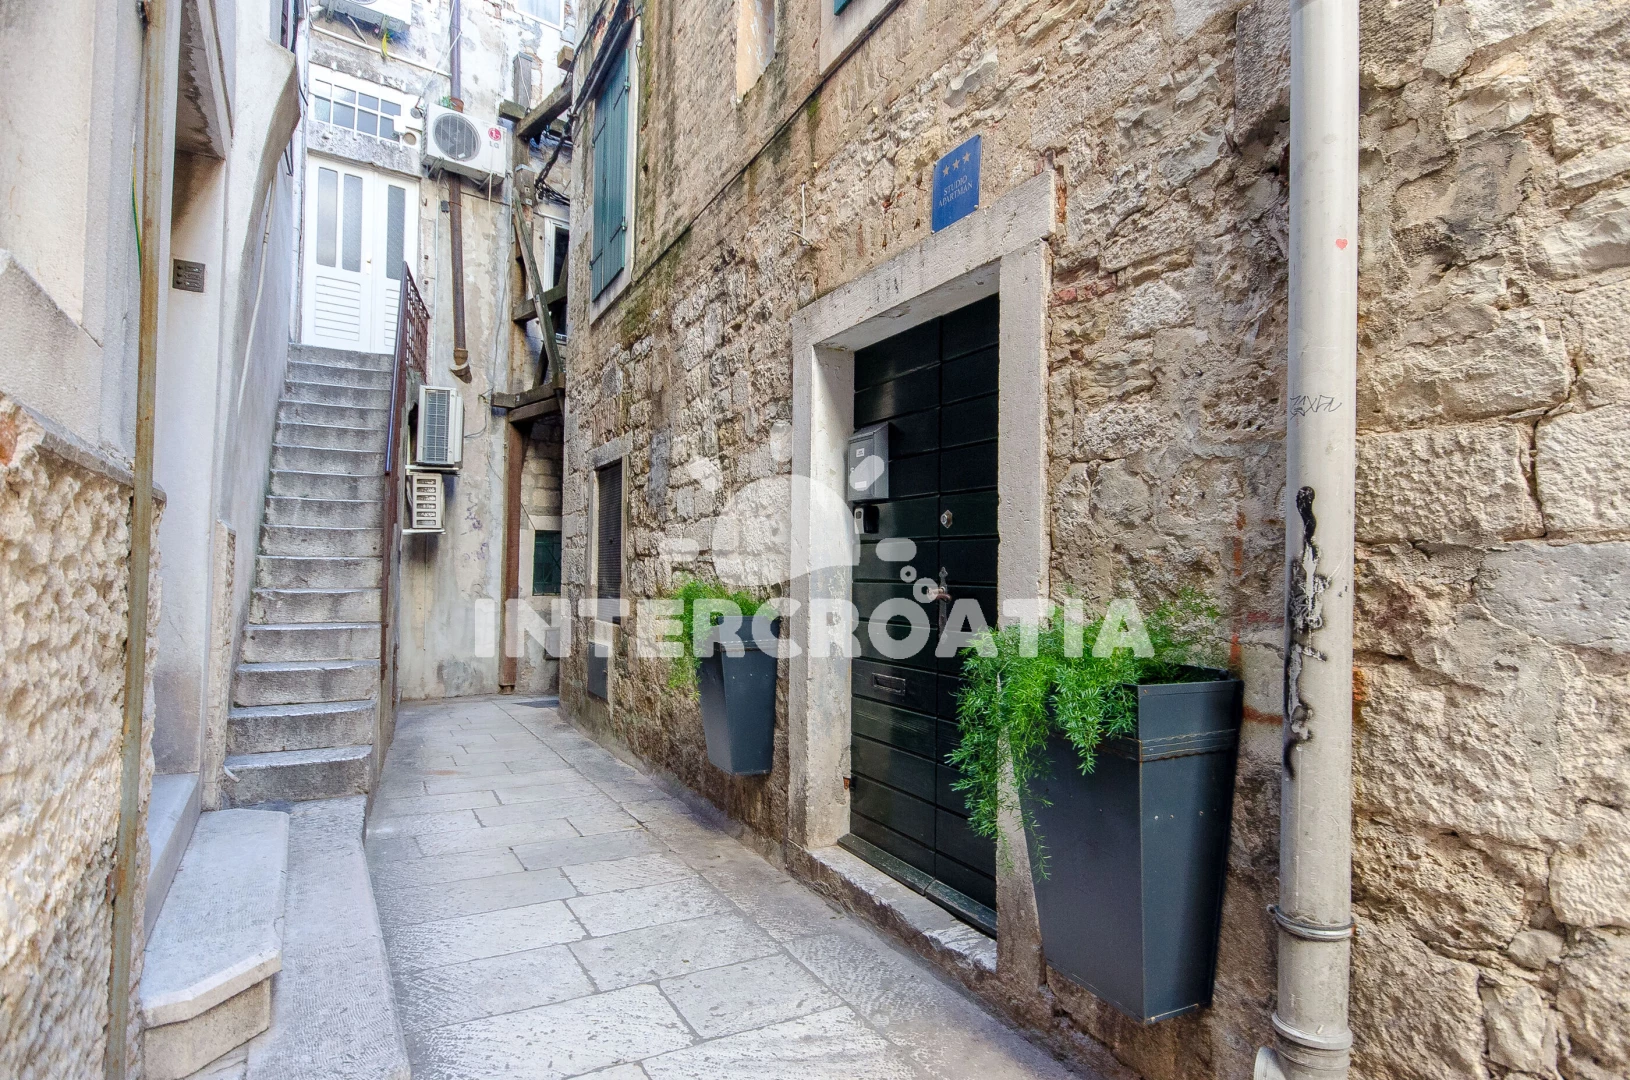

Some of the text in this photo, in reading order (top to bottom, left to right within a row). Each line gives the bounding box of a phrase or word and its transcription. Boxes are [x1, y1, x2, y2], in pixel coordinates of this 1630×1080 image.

[489, 140, 500, 149] LG
[939, 181, 973, 207] APARTMAN
[943, 175, 968, 196] STUDIO
